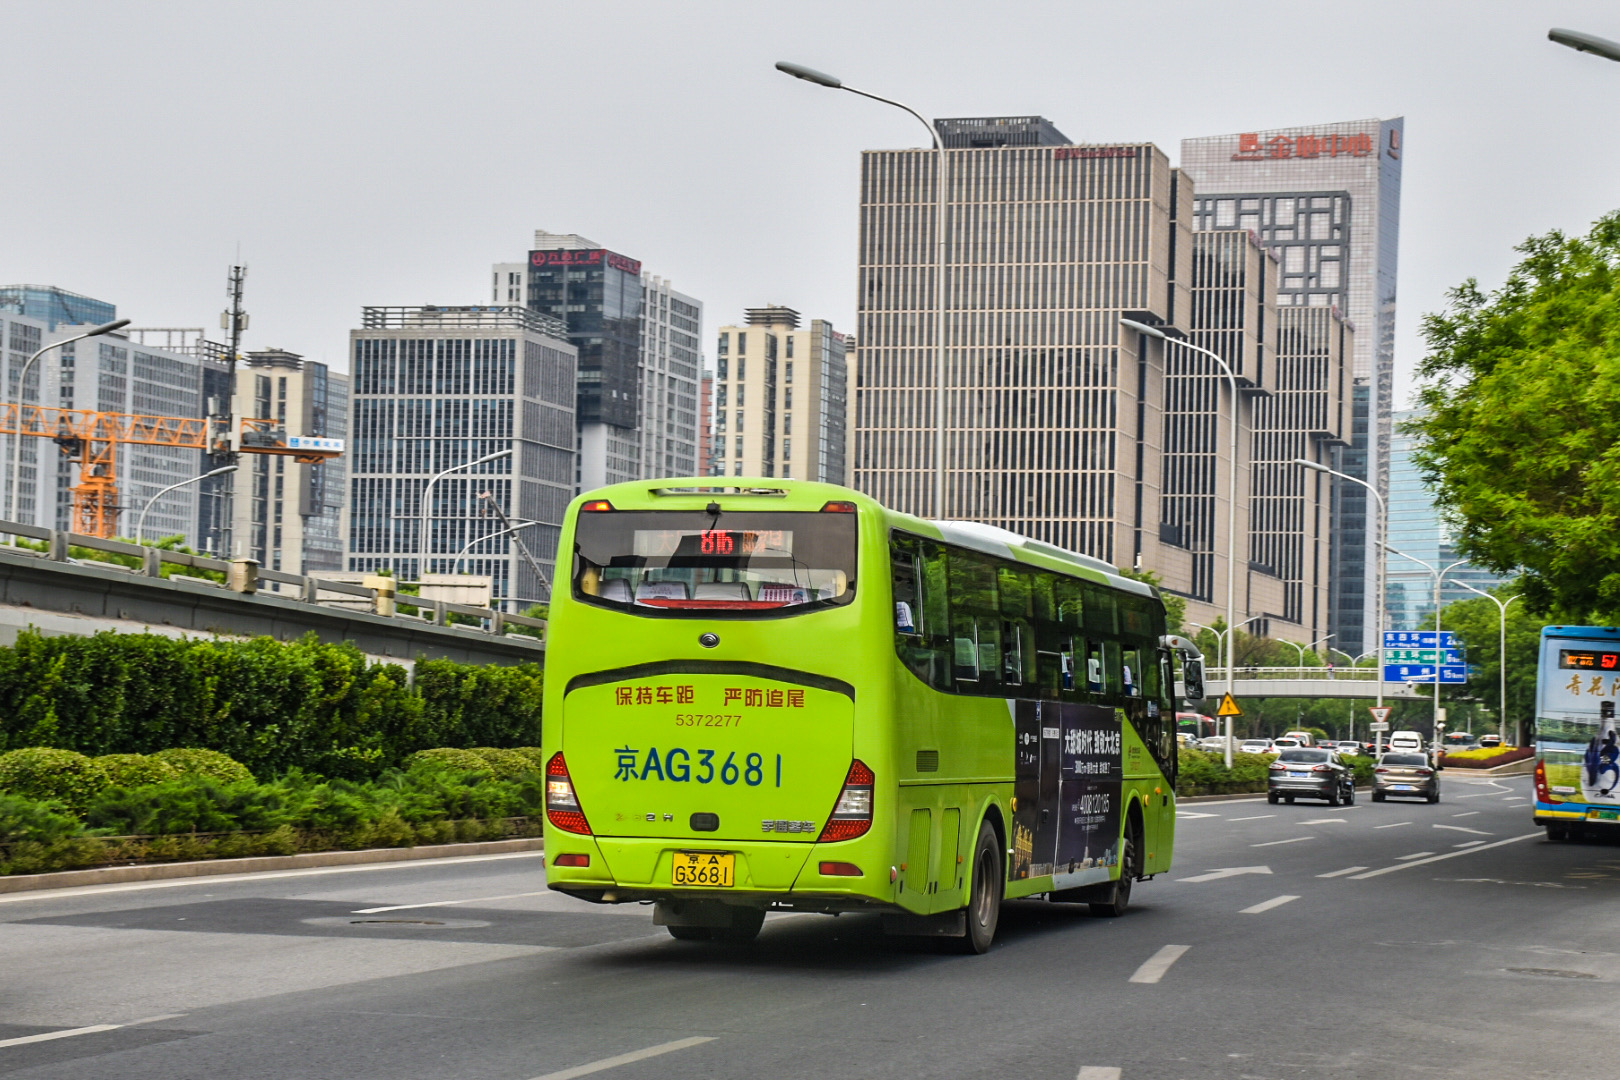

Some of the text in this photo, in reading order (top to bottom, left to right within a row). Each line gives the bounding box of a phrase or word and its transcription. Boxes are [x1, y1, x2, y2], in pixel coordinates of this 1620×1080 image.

[1268, 133, 1373, 160] 金地中心
[548, 251, 601, 260] 万达广场
[701, 529, 735, 555] 816
[615, 685, 806, 708] 保持车距 严防追尾
[675, 713, 743, 728] 5372277
[613, 744, 783, 788] 京AG3681
[761, 819, 817, 834] 宇通客车
[675, 865, 728, 884] G3681
